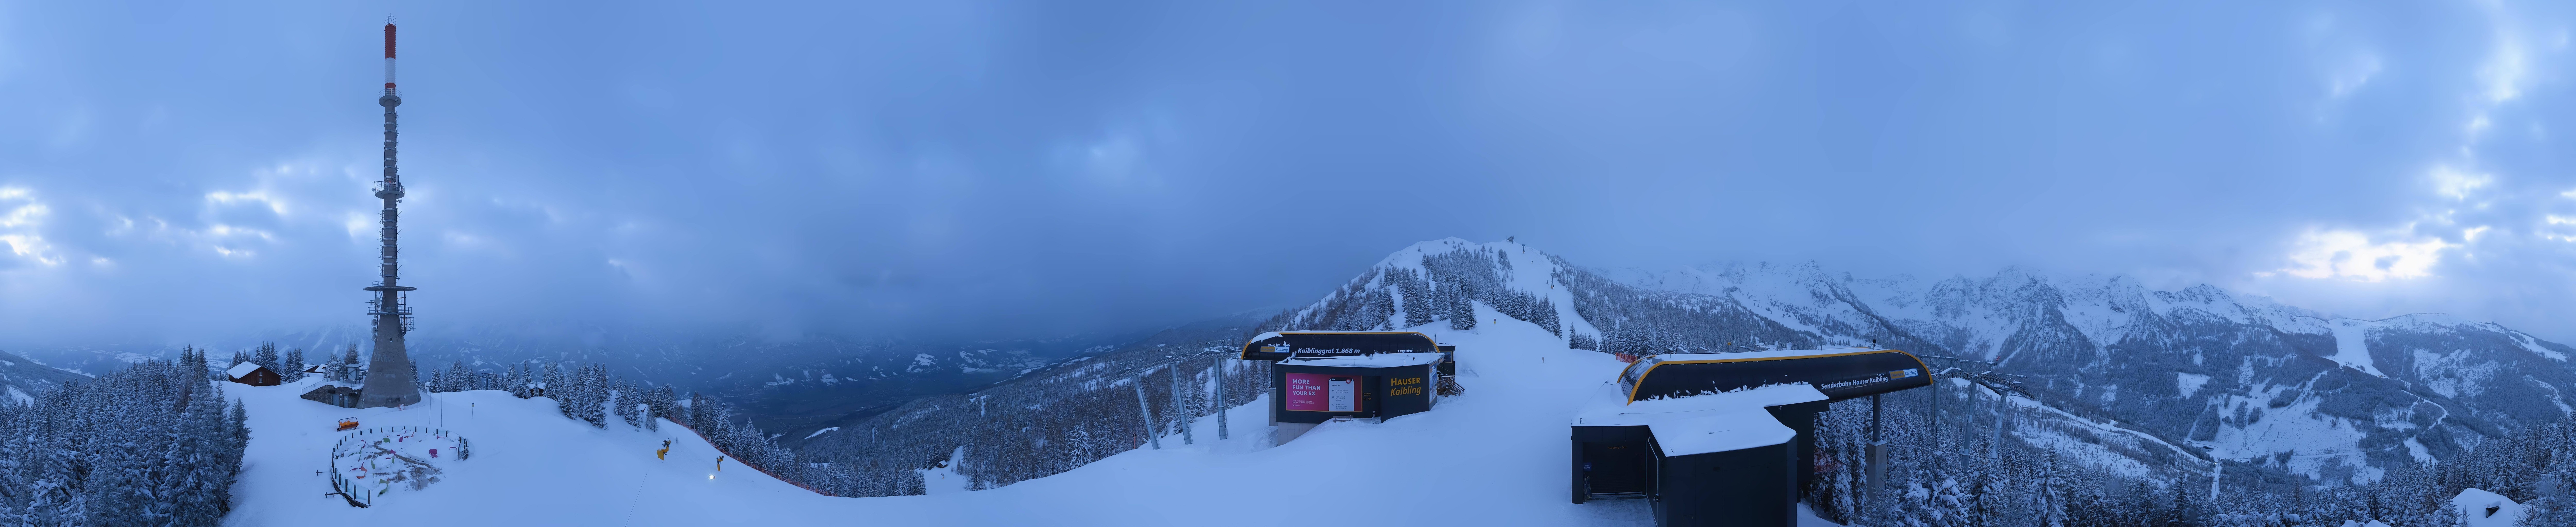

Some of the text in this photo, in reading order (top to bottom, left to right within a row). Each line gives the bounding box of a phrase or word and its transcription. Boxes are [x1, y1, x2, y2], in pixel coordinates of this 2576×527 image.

[1391, 377, 1420, 386] HAUSER
[1821, 380, 1851, 389] Senderbahn
[1391, 386, 1421, 396] Kaibling
